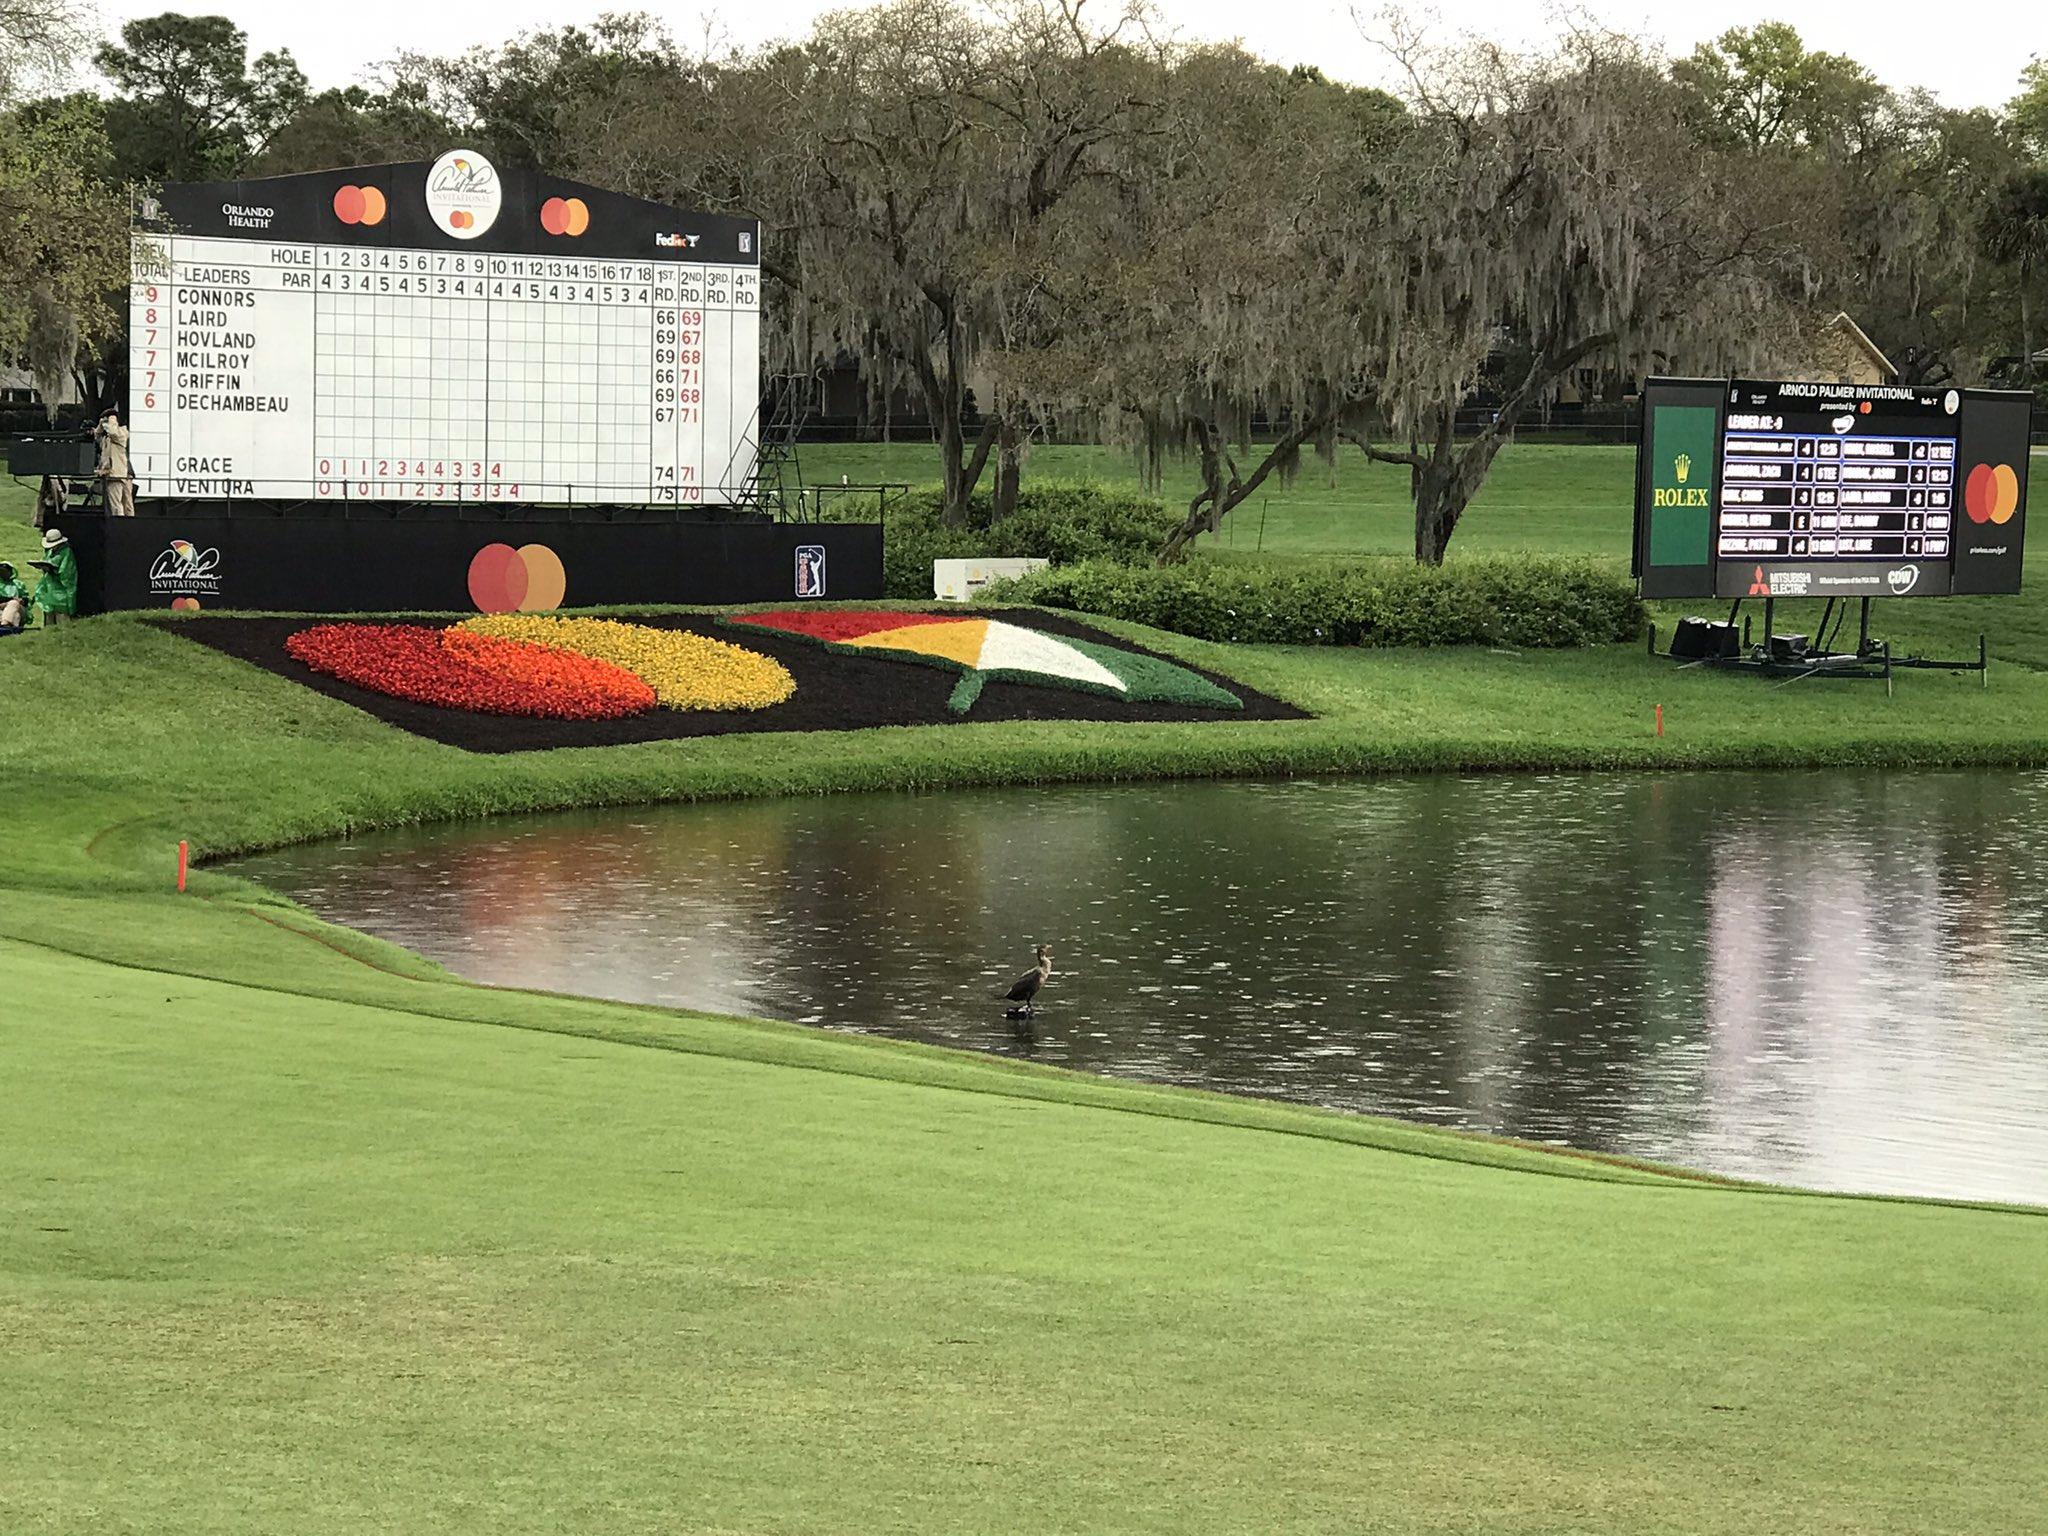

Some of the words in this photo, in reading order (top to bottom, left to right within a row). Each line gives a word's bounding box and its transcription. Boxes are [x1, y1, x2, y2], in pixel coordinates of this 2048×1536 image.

[222, 204, 274, 217] ORLANDO
[228, 215, 271, 228] HEALTH
[272, 249, 311, 264] HOLE
[324, 252, 329, 265] 1
[342, 252, 350, 266] 2
[361, 253, 370, 267] 3
[380, 255, 389, 268] 4
[399, 255, 408, 269] 5
[418, 256, 427, 270] 6
[438, 258, 446, 271] 7
[456, 258, 465, 272] 8
[475, 259, 483, 273] 9
[491, 260, 506, 274] 10
[512, 261, 523, 274] 11
[529, 262, 543, 275] 12
[548, 263, 561, 277] 13
[565, 264, 579, 277] 14
[583, 265, 597, 278] 15
[602, 266, 615, 280] 16
[620, 267, 632, 280] 17
[638, 267, 651, 281] 18
[185, 267, 250, 285] LEADERS
[283, 273, 310, 287] PAR
[322, 274, 330, 288] 4
[341, 275, 350, 289] 3
[360, 276, 369, 290] 4
[380, 277, 389, 291] 5
[399, 278, 407, 293] 4
[418, 278, 427, 292] 5
[438, 279, 446, 293] 3
[455, 281, 464, 295] 4
[475, 282, 482, 296] 4
[494, 282, 502, 296] 4
[512, 283, 521, 297] 4
[531, 284, 539, 298] 5
[550, 285, 558, 299] 4
[568, 286, 575, 300] 3
[585, 287, 593, 301] 4
[604, 287, 612, 301] 5
[622, 288, 629, 302] 3
[639, 289, 647, 303] 4
[655, 288, 676, 301] RD.
[681, 289, 702, 302] RD.
[708, 290, 729, 303] RD.
[146, 287, 157, 302] 9
[178, 289, 255, 307] CONNORS
[657, 310, 675, 325] 66
[682, 311, 701, 325] 69
[736, 291, 757, 304] RD.
[146, 309, 156, 324] 8
[179, 310, 227, 327] LAIRD
[657, 330, 675, 344] 69
[682, 330, 700, 345] 67
[146, 330, 156, 345] 7
[178, 331, 255, 348] HOVLAND
[656, 349, 675, 364] 69
[682, 350, 700, 364] 68
[147, 351, 156, 366] 7
[177, 352, 249, 369] MCILROY
[656, 369, 674, 383] 66
[682, 369, 697, 384] 71
[146, 372, 155, 387] 7
[178, 373, 240, 390] GRIFFIN
[656, 388, 674, 402] 69
[681, 389, 699, 403] 68
[1779, 384, 1817, 397] ARNOLD
[1819, 386, 1855, 398] PALMER
[1856, 387, 1915, 400] INVITATIONAL
[145, 393, 155, 408] 6
[178, 394, 288, 412] DECHAMBEAU
[656, 408, 674, 422] 67
[682, 408, 697, 423] 71
[177, 457, 232, 473] GRACE
[320, 460, 329, 474] 0
[379, 461, 388, 475] 2
[398, 461, 406, 475] 3
[416, 462, 424, 476] 4
[435, 462, 443, 476] 4
[454, 463, 462, 477] 3
[472, 463, 481, 477] 3
[492, 463, 500, 477] 4
[655, 466, 673, 481] 74
[681, 467, 694, 481] 71
[177, 480, 254, 494] VENTURA
[682, 487, 699, 499] 70
[1653, 488, 1709, 507] ROLEX
[151, 580, 219, 590] INVITATIONAL
[1769, 573, 1812, 584] MITSUBISHI
[1887, 570, 1912, 585] CDW
[1770, 583, 1808, 595] ELECTRIC
